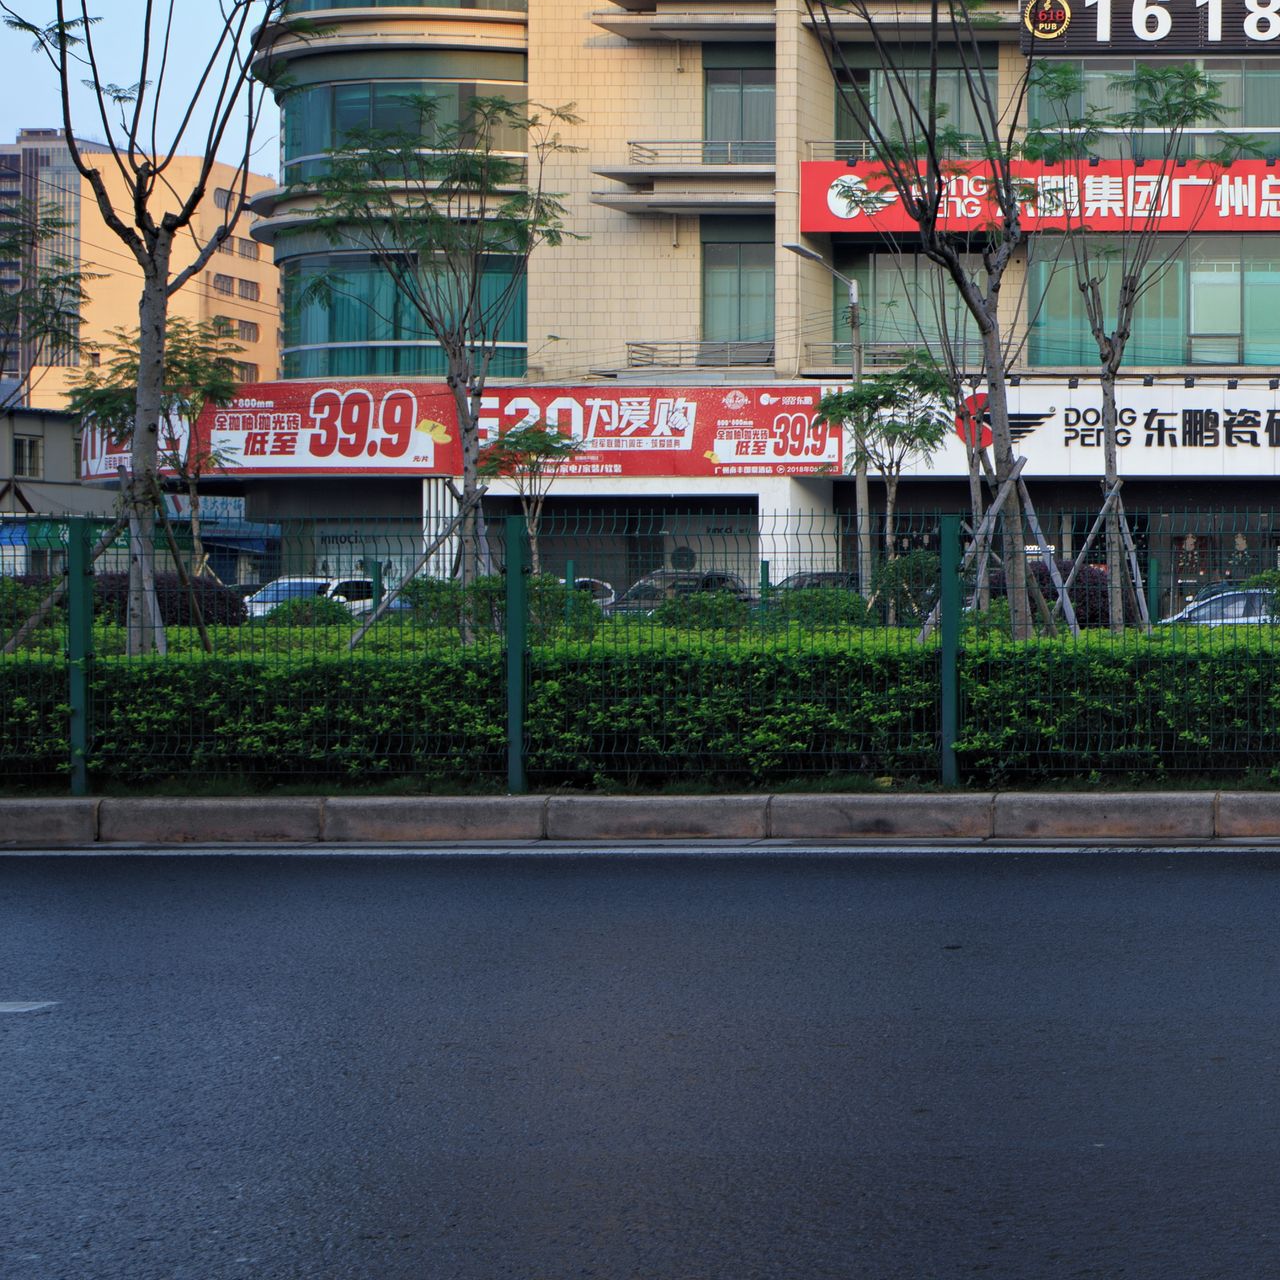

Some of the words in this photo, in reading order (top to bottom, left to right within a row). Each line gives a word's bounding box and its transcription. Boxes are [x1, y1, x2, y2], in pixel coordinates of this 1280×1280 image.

[1033, 9, 1065, 21] 618
[308, 391, 415, 458] 39.9
[1064, 407, 1137, 427] DOG
[244, 432, 298, 456] 低至
[773, 413, 829, 457] 39.9
[735, 441, 767, 456] 低至
